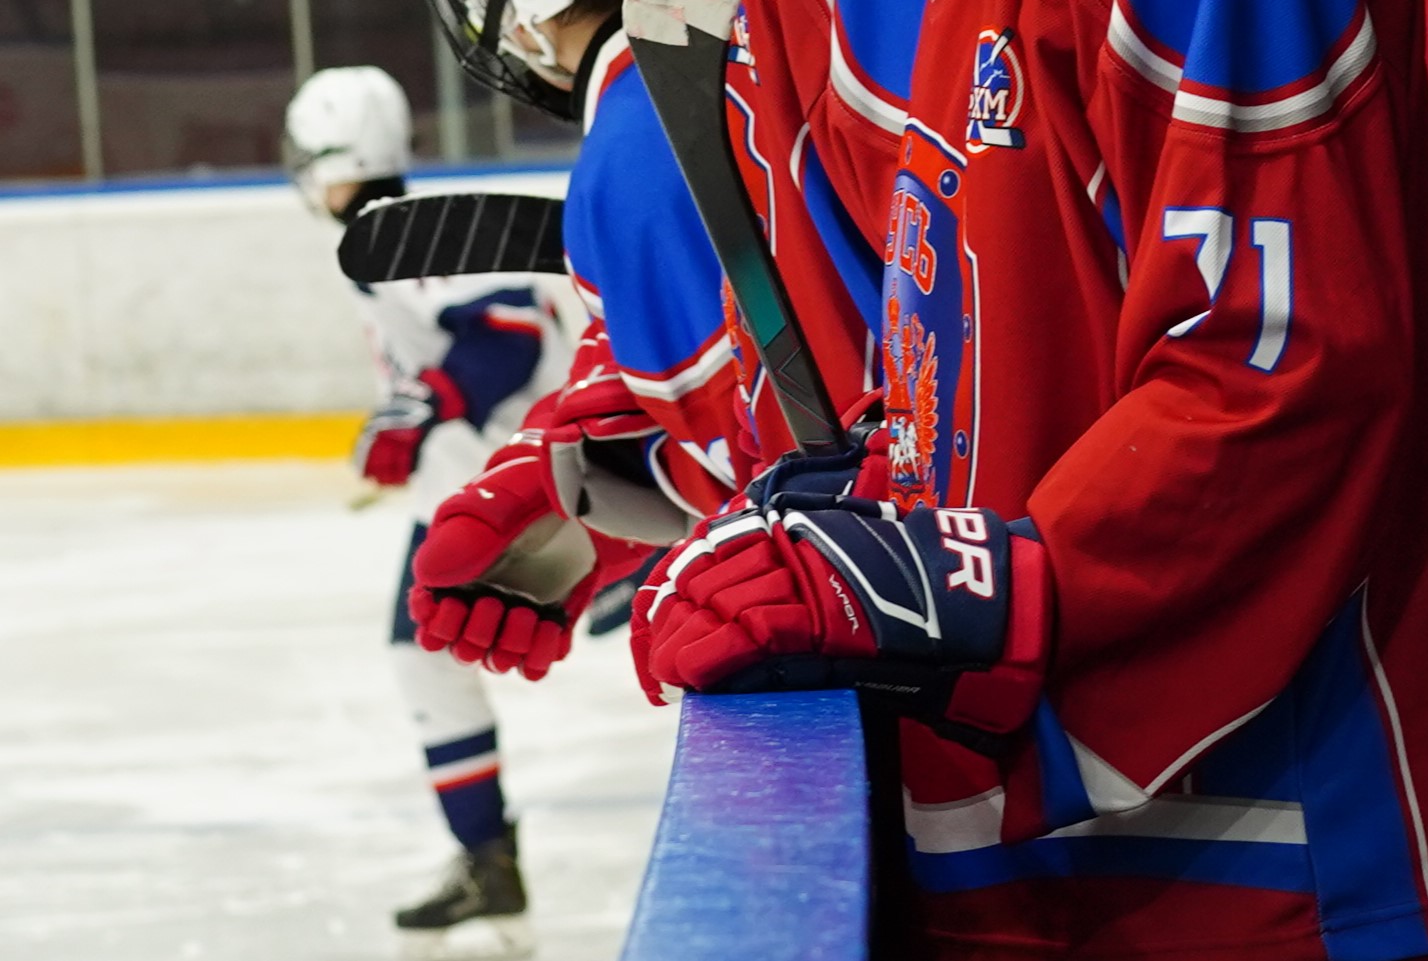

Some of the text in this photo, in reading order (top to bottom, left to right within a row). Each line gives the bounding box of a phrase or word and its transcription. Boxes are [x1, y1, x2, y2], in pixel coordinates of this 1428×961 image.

[968, 86, 1009, 121] ХМ
[1164, 207, 1293, 374] 71
[828, 573, 860, 636] VAPOR
